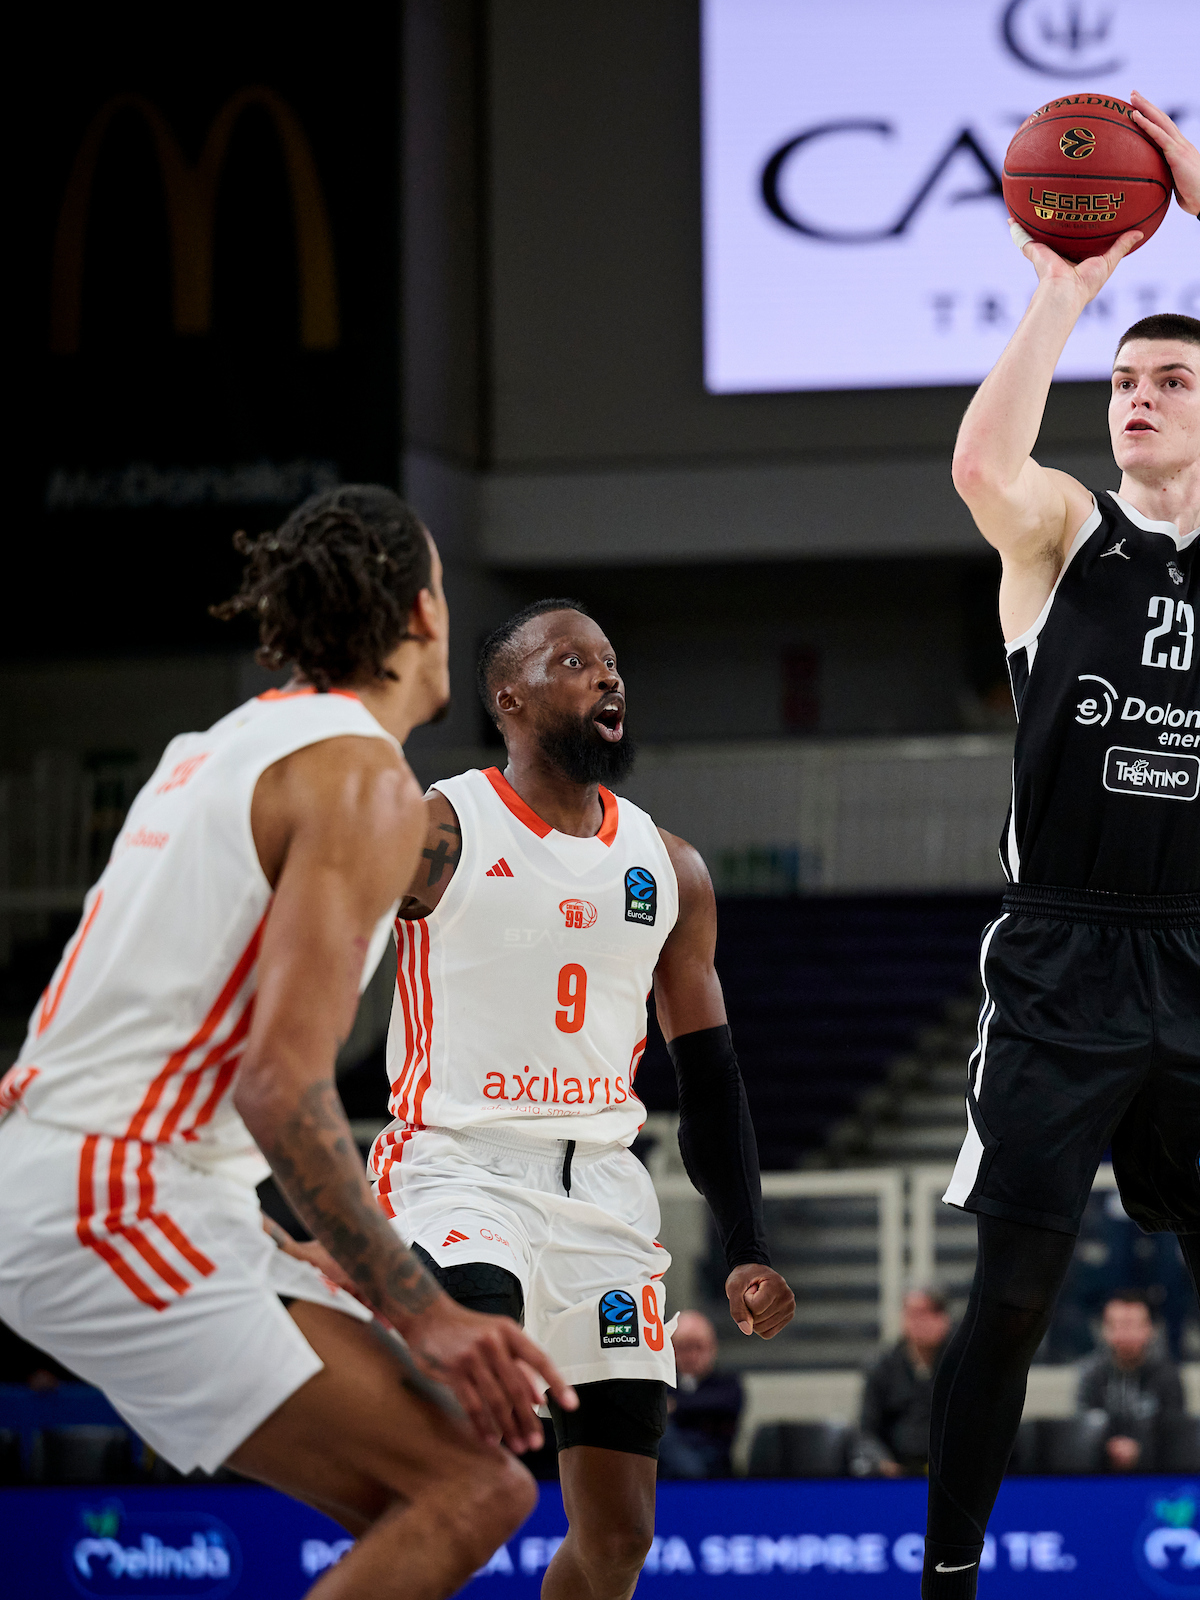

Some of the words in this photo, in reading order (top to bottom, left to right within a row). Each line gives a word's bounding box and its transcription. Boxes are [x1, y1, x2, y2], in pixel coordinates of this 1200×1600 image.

[1028, 186, 1125, 211] LEGACY
[1055, 212, 1117, 222] 1000
[1141, 595, 1195, 672] 23
[1116, 760, 1190, 790] TRENTINO
[627, 909, 654, 922] EuroCup
[630, 900, 652, 911] BKT
[565, 910, 583, 929] 99
[554, 963, 588, 1034] 9
[482, 1065, 628, 1105] axilaris
[606, 1325, 632, 1334] BKT
[642, 1284, 664, 1352] 9
[602, 1335, 637, 1344] EuroCup
[700, 1533, 889, 1576] SEMPRE
